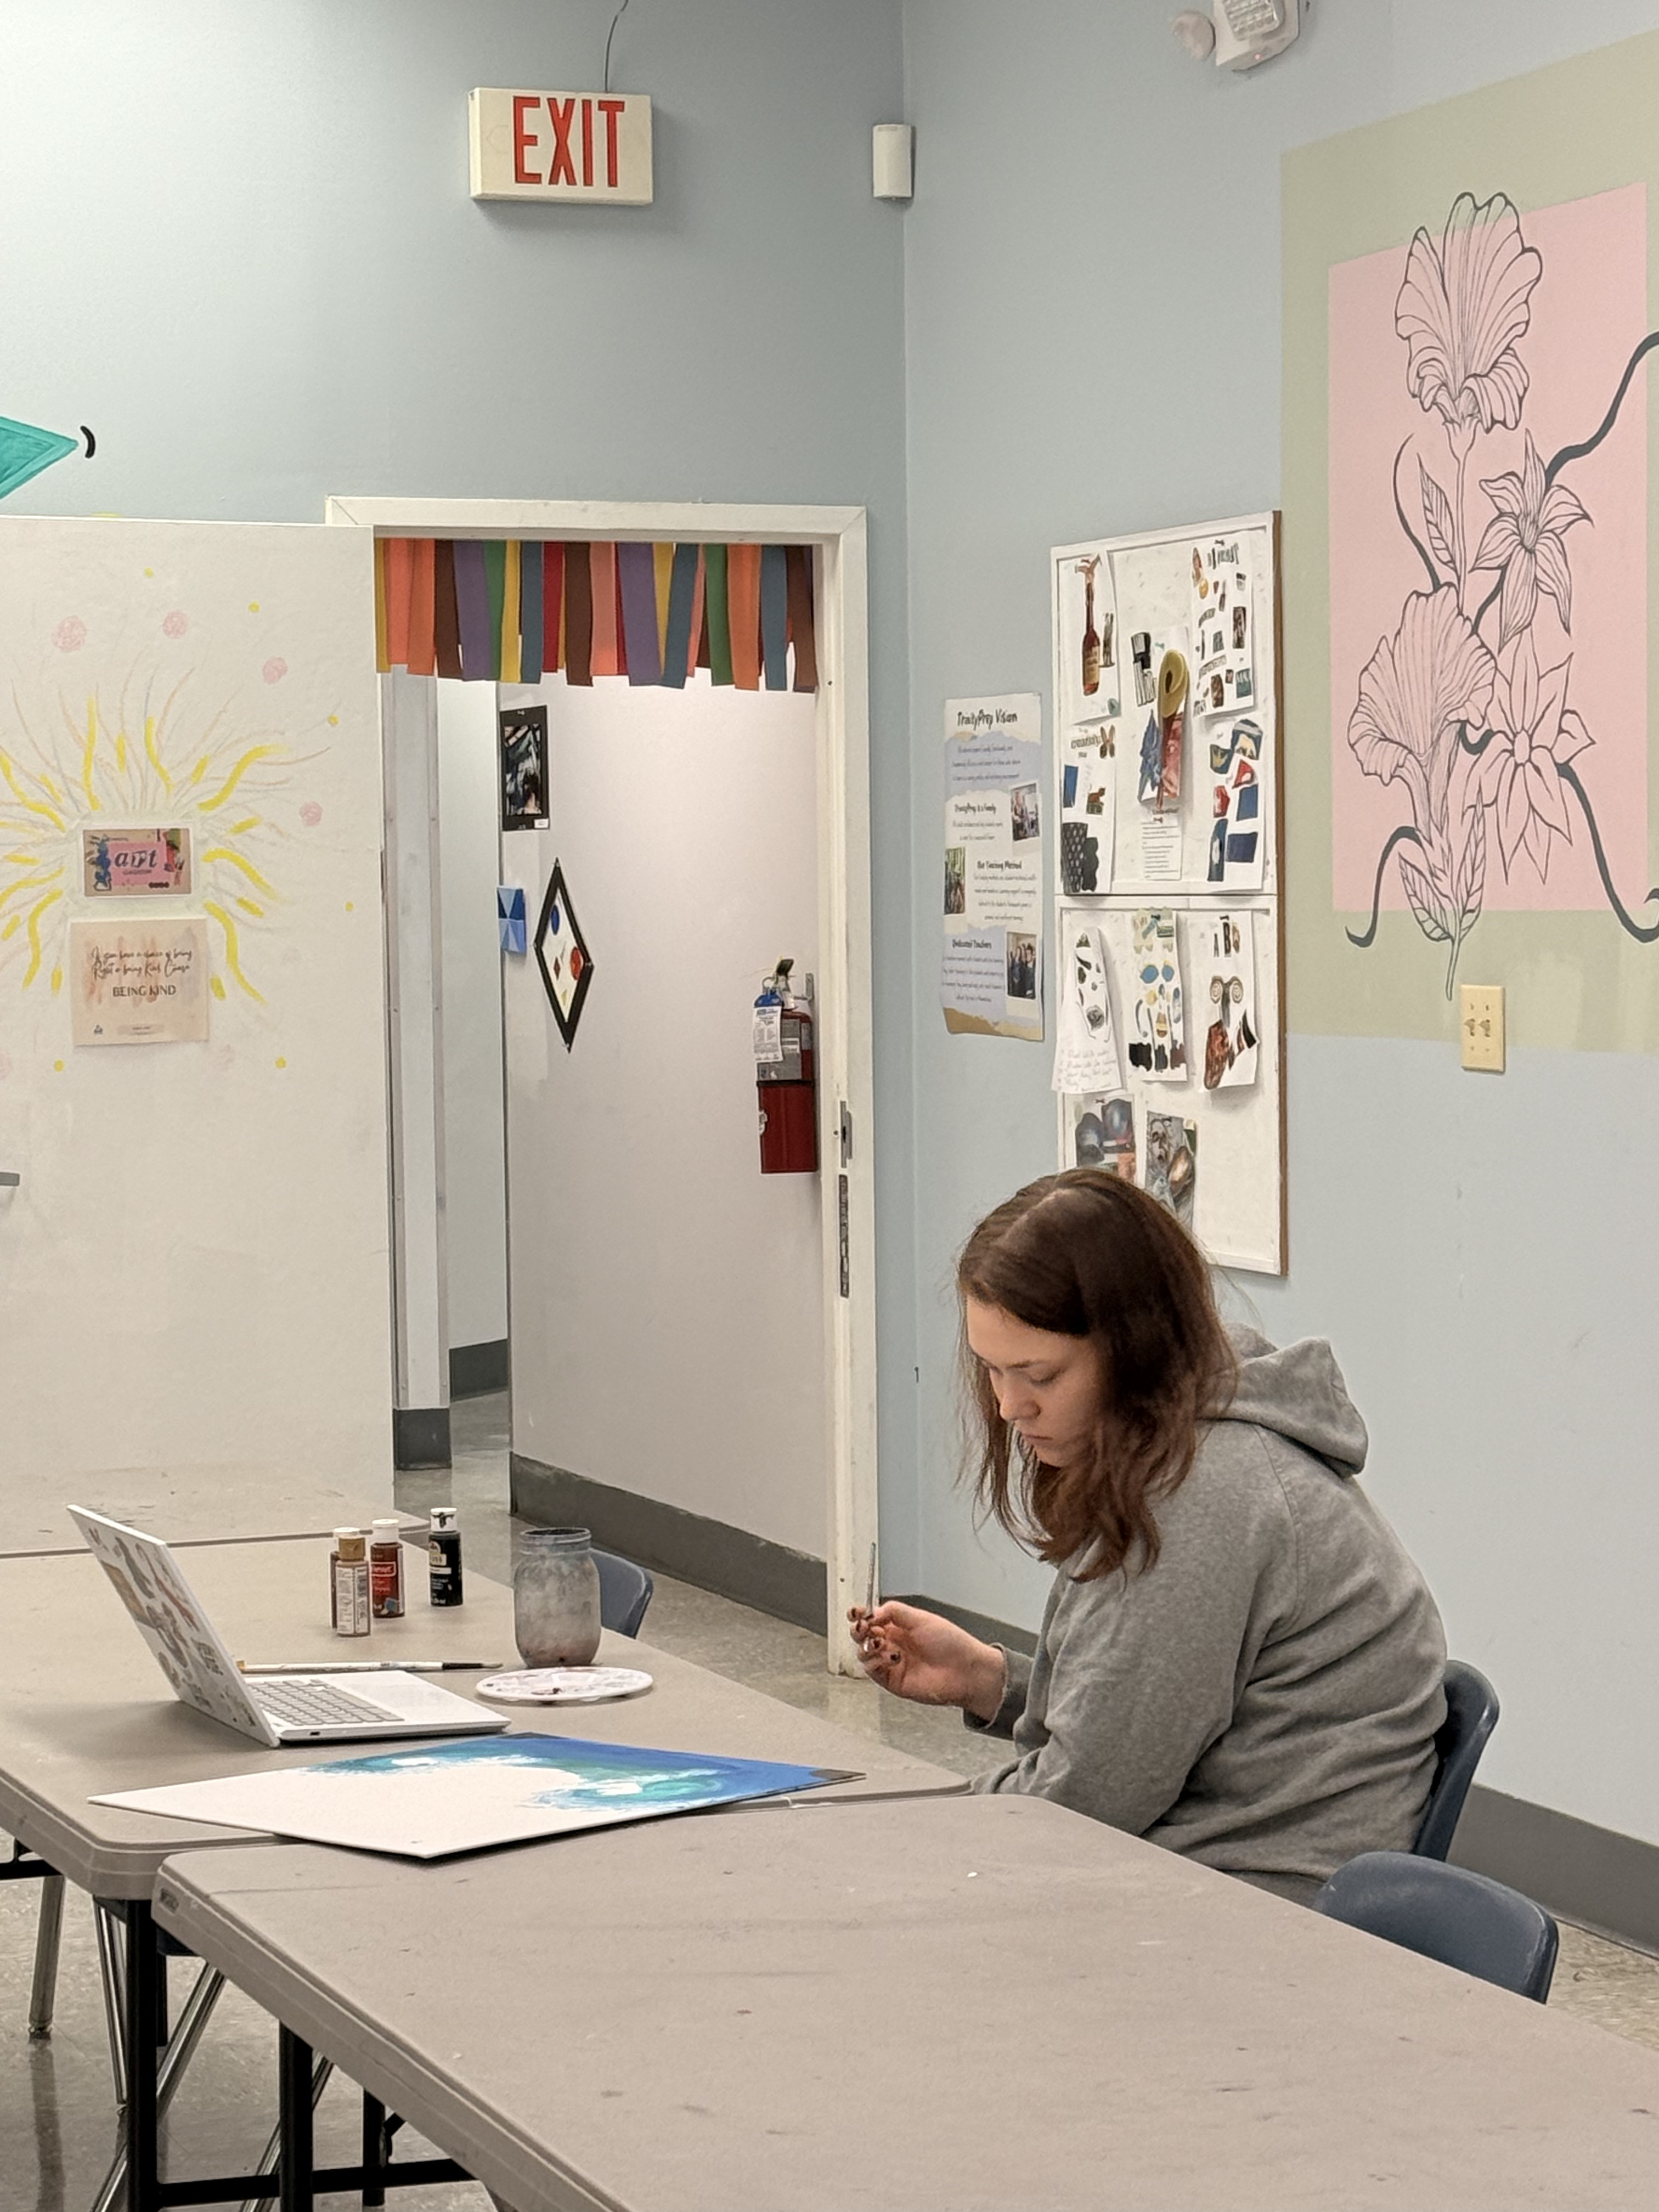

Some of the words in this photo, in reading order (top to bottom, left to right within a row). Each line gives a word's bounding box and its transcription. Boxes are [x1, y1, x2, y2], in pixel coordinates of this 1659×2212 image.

[512, 95, 625, 188] EXIT
[114, 849, 157, 868] art
[112, 986, 147, 997] BEING
[149, 984, 177, 996] KIND
